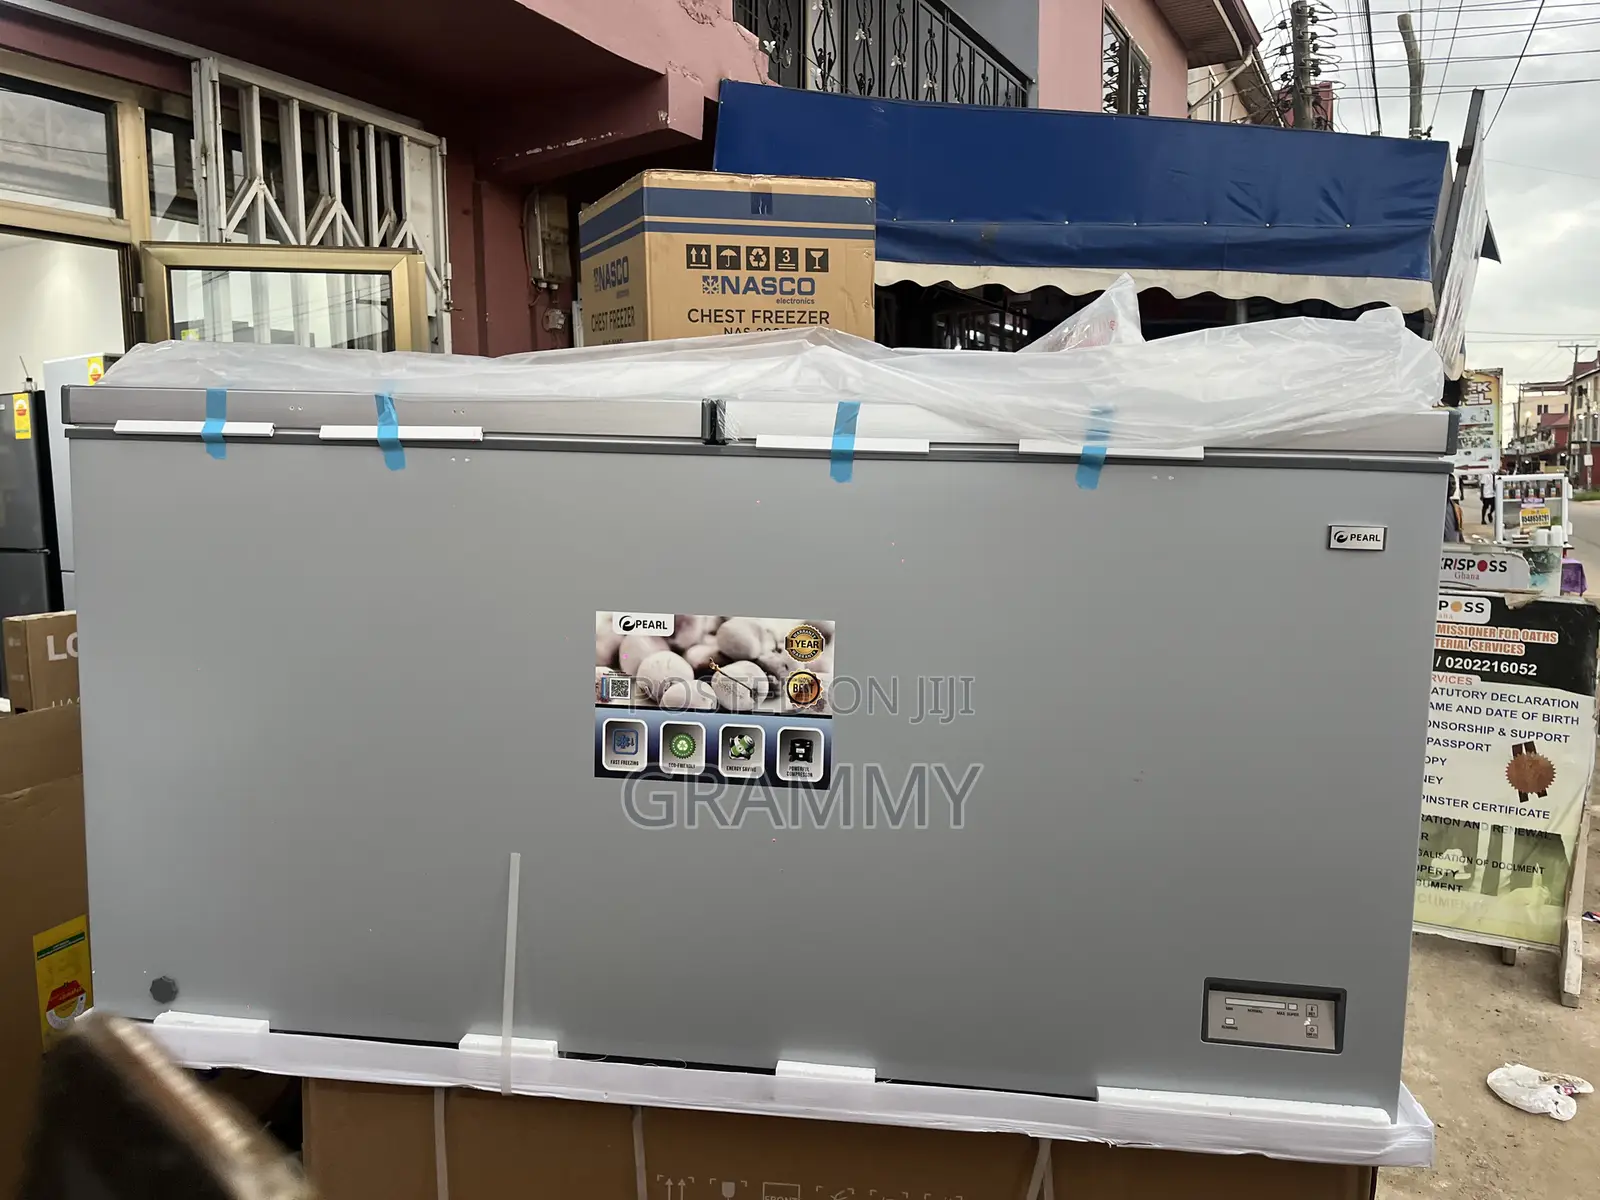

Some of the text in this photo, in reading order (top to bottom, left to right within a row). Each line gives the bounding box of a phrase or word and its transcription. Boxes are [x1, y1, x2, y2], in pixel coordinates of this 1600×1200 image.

[598, 256, 630, 291] NASCO
[721, 276, 816, 296] NASCO
[775, 297, 815, 305] electronics
[591, 306, 635, 332] CHEST FREEZER
[688, 308, 830, 324] CHEST FREEZER
[1464, 393, 1492, 405] EL
[1350, 534, 1381, 542] PEARL
[1455, 572, 1479, 580] Ghana
[636, 620, 667, 629] PEARL
[1437, 624, 1557, 643] MISSIONER FOR OATHS
[795, 640, 819, 649] YEAR
[1435, 639, 1524, 655] TERIAL SERVICES
[1445, 656, 1538, 676] 0202216052
[1431, 687, 1579, 709] ATUTORY DECLARATION
[1456, 705, 1482, 715] AND
[1486, 707, 1518, 719] DATE
[1522, 711, 1538, 721] OF
[1542, 713, 1580, 725] BIRTH
[1498, 728, 1506, 737] &
[1510, 729, 1570, 744] SUPPORT
[1426, 737, 1491, 752] PASSPORT
[1473, 801, 1550, 819] CERTIFICATE
[1464, 820, 1489, 831] AND
[1417, 865, 1459, 878] PERTY
[1475, 858, 1489, 866] OF
[1491, 861, 1546, 875] DOCUMENT
